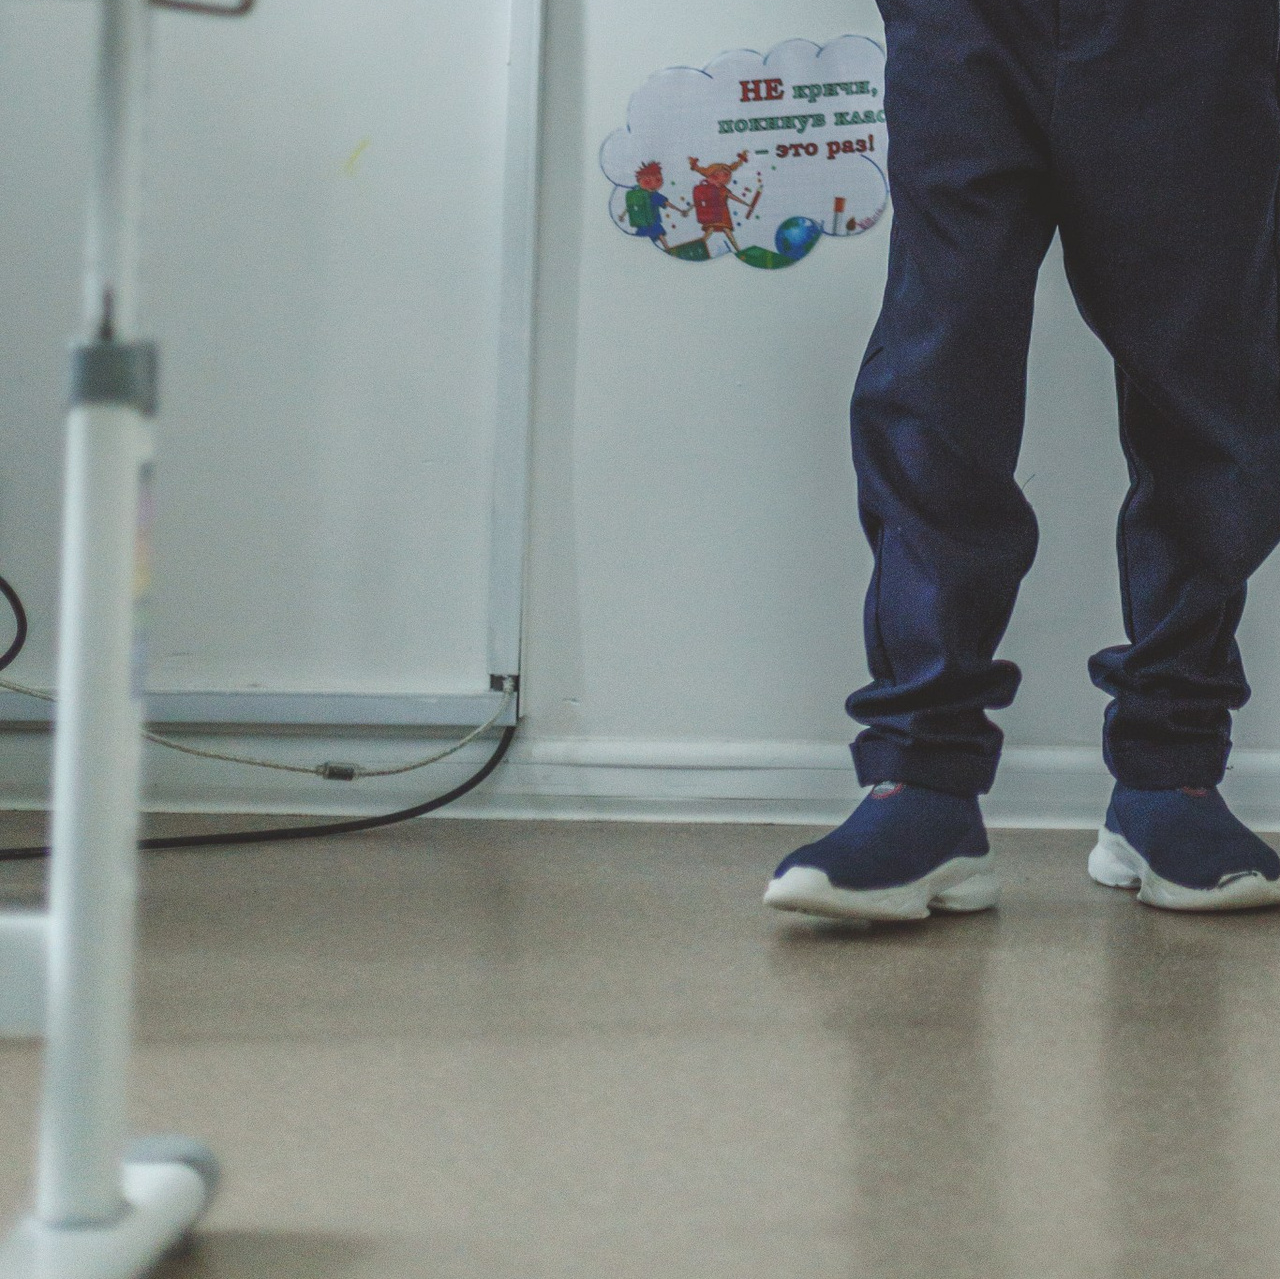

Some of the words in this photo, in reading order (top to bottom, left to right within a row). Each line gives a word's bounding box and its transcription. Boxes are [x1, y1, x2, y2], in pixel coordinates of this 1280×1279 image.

[739, 78, 785, 103] НЕ
[792, 80, 878, 103] кричи,
[718, 113, 826, 134] покинув
[775, 143, 818, 159] это
[827, 134, 875, 159] раз!
